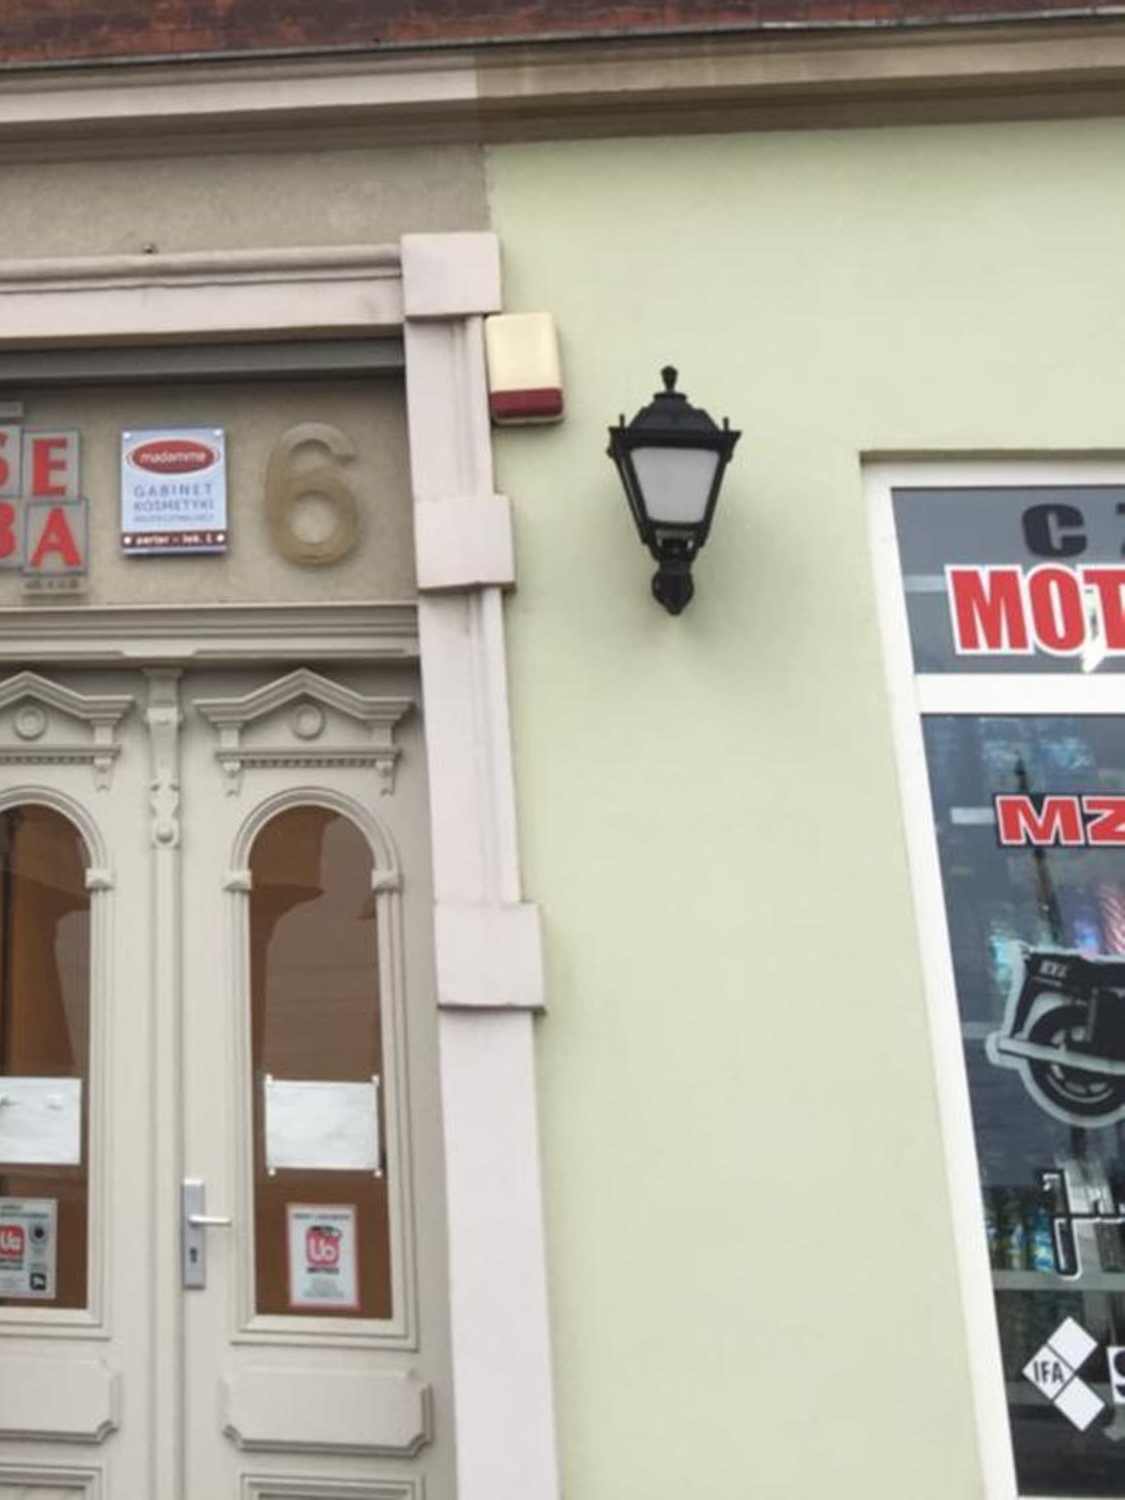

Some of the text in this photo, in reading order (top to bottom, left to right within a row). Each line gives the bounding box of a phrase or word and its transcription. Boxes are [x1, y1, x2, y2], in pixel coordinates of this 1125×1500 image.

[133, 483, 213, 498] GABINET
[266, 422, 357, 568] 6
[133, 499, 215, 512] KOSMETYKI
[1033, 1361, 1064, 1384] IFA
